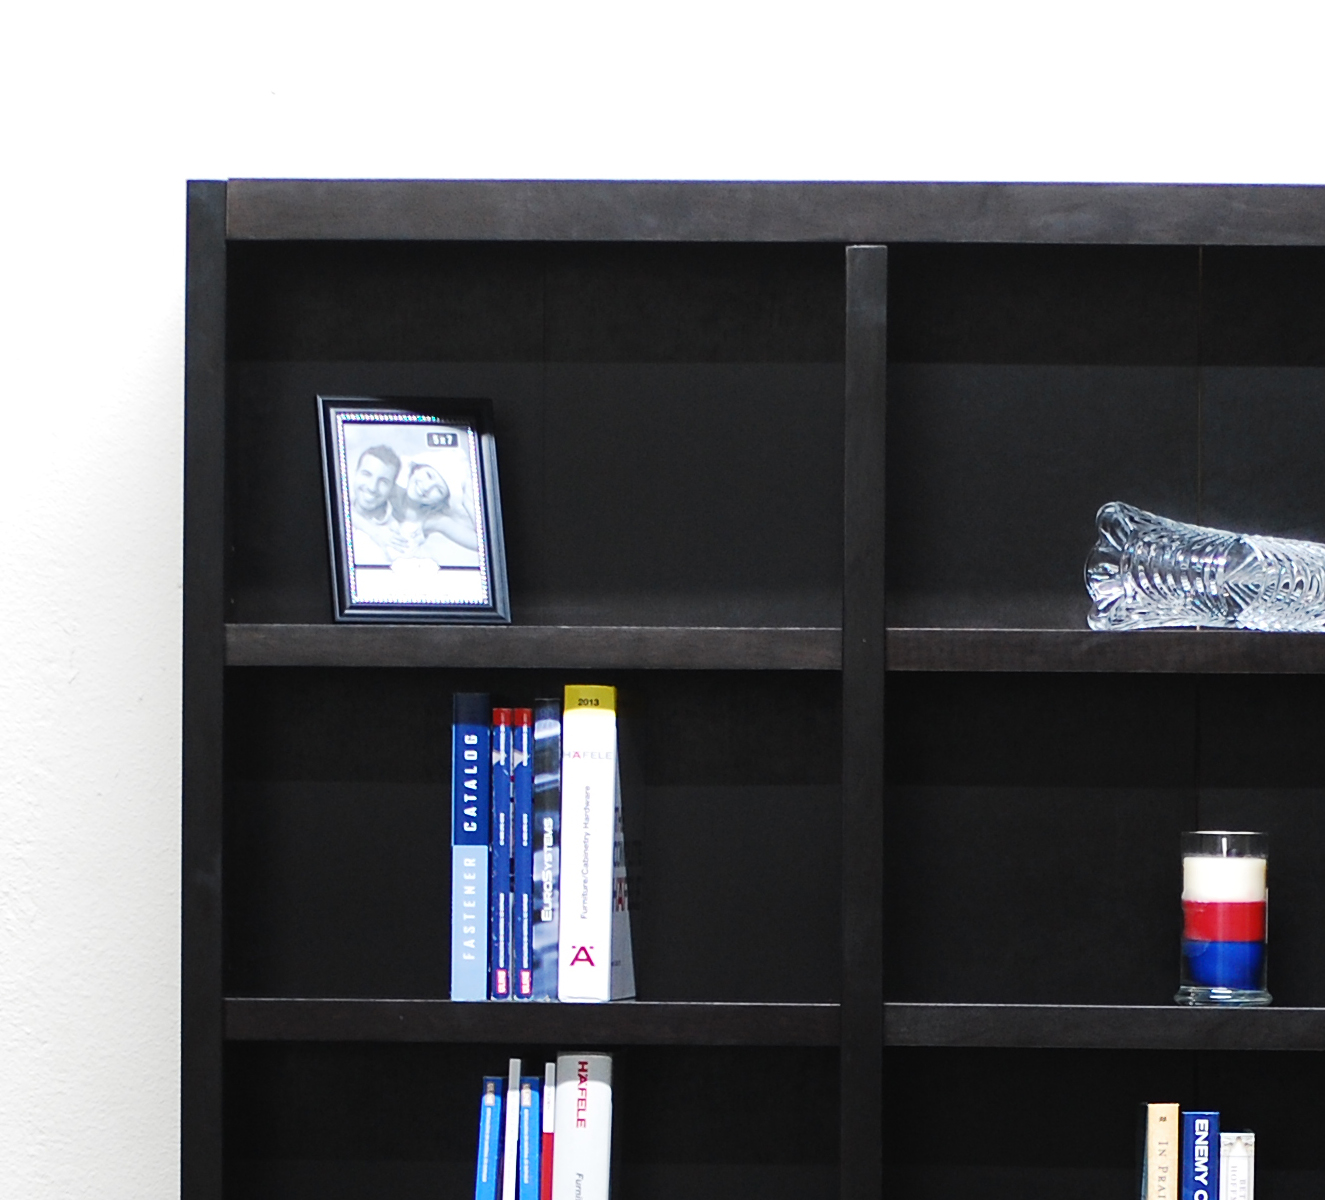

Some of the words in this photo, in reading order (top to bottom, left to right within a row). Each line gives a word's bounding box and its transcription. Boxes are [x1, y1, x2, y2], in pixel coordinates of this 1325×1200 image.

[578, 698, 600, 706] 2013
[464, 734, 478, 832] CATALOG
[583, 785, 591, 828] Hardware
[580, 831, 591, 919] Furniture/Cabinetry
[463, 858, 476, 960] FASTENER
[1158, 1141, 1168, 1157] IN
[1194, 1119, 1209, 1186] ENEMY
